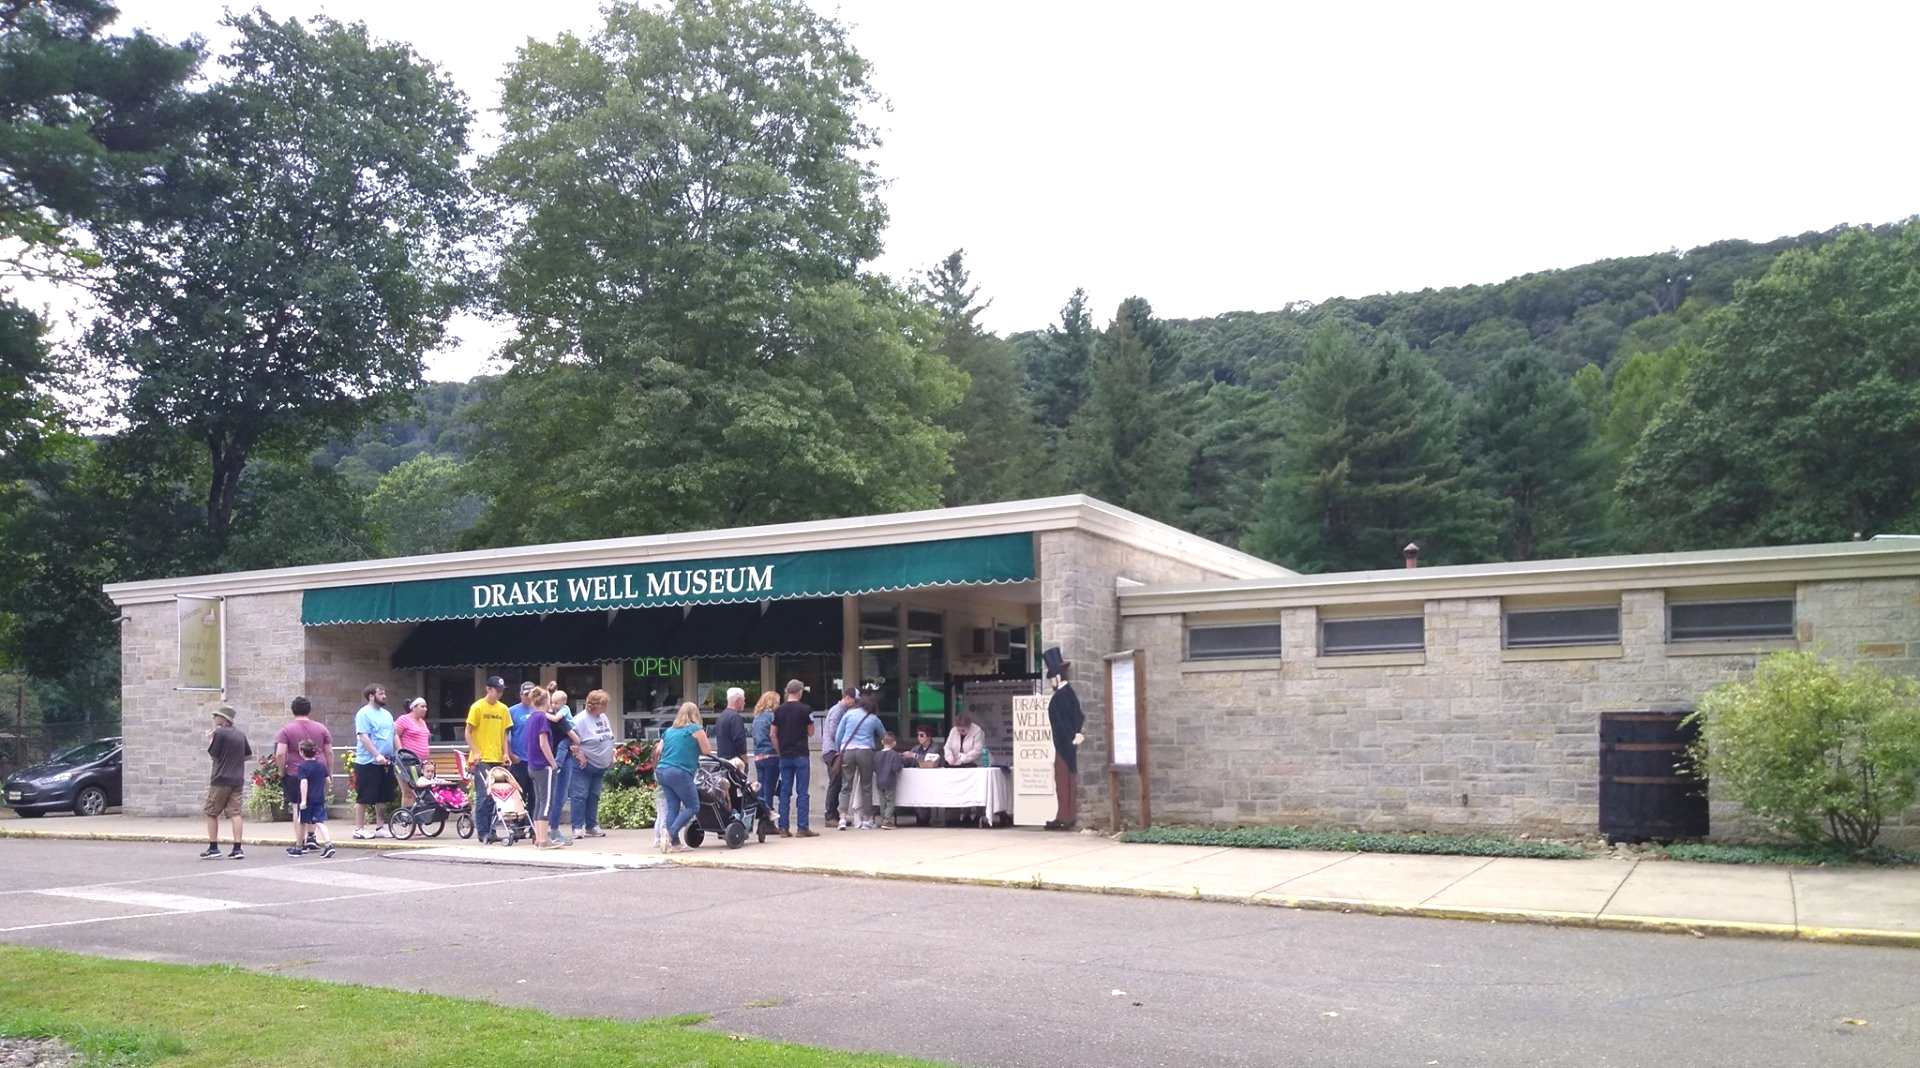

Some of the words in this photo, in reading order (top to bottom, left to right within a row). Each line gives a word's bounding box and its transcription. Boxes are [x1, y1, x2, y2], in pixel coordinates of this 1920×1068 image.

[473, 579, 559, 608] DRAKE
[567, 574, 638, 602] WELL
[646, 565, 774, 597] MUSEUM
[634, 657, 681, 677] OPEN
[1014, 698, 1049, 711] DRAKE
[1016, 712, 1050, 727] WELL
[1014, 729, 1051, 741] MUSEUM
[1020, 749, 1049, 760] OPEN
